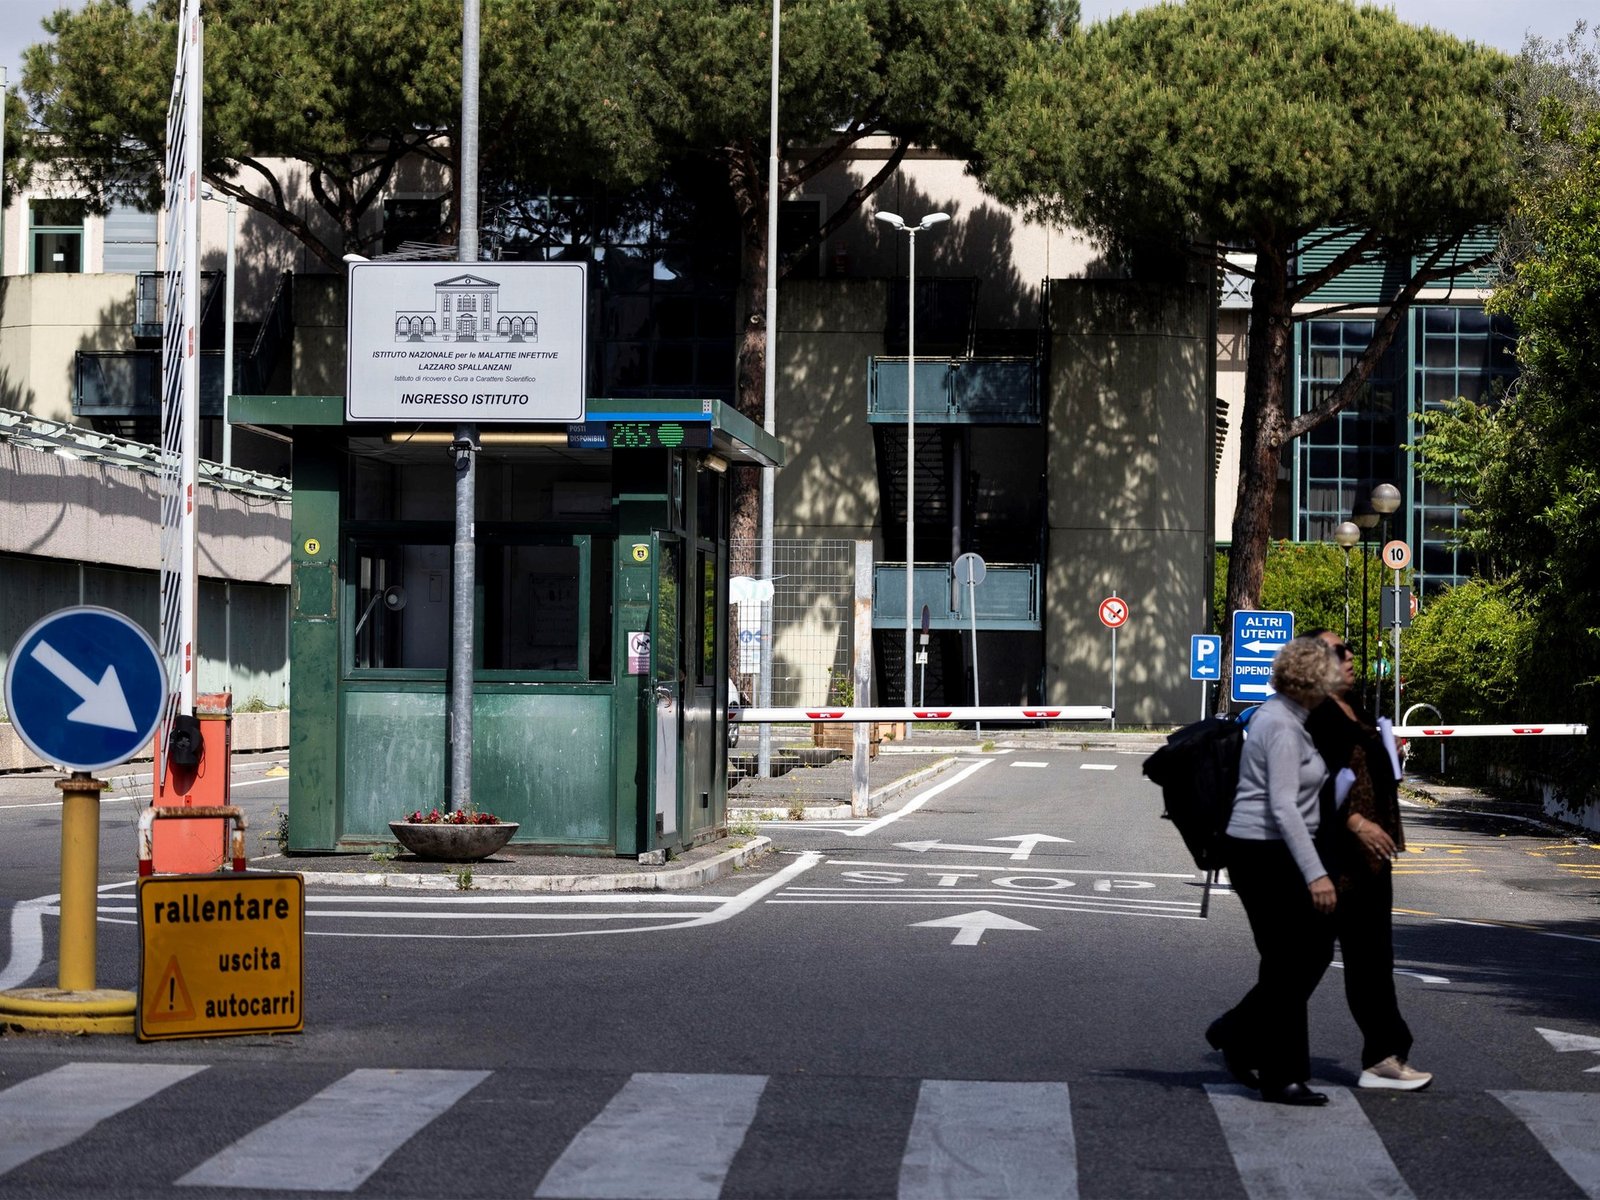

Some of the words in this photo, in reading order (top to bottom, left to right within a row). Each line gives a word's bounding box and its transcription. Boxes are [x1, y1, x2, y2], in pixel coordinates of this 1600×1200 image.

[372, 351, 408, 359] ISTITUTO
[408, 351, 454, 359] NAZIONALE
[454, 352, 468, 360] per
[469, 351, 476, 359] le
[418, 363, 456, 371] LAZZARO
[457, 363, 513, 371] SPALLANZANI
[476, 375, 504, 383] Carattere
[505, 375, 536, 383] Scientifico
[400, 393, 468, 405] INGRESSO
[471, 393, 529, 405] ISTITUTO
[569, 425, 586, 433] POSTI
[612, 423, 651, 447] 265
[1391, 548, 1404, 561] 10
[1245, 617, 1283, 627] ALTRI
[1241, 629, 1287, 639] UTENTI
[1197, 640, 1215, 661] P
[840, 869, 1156, 892] STOP
[154, 893, 290, 924] rallentare
[219, 947, 281, 972] uscita
[205, 990, 295, 1018] autocarri
